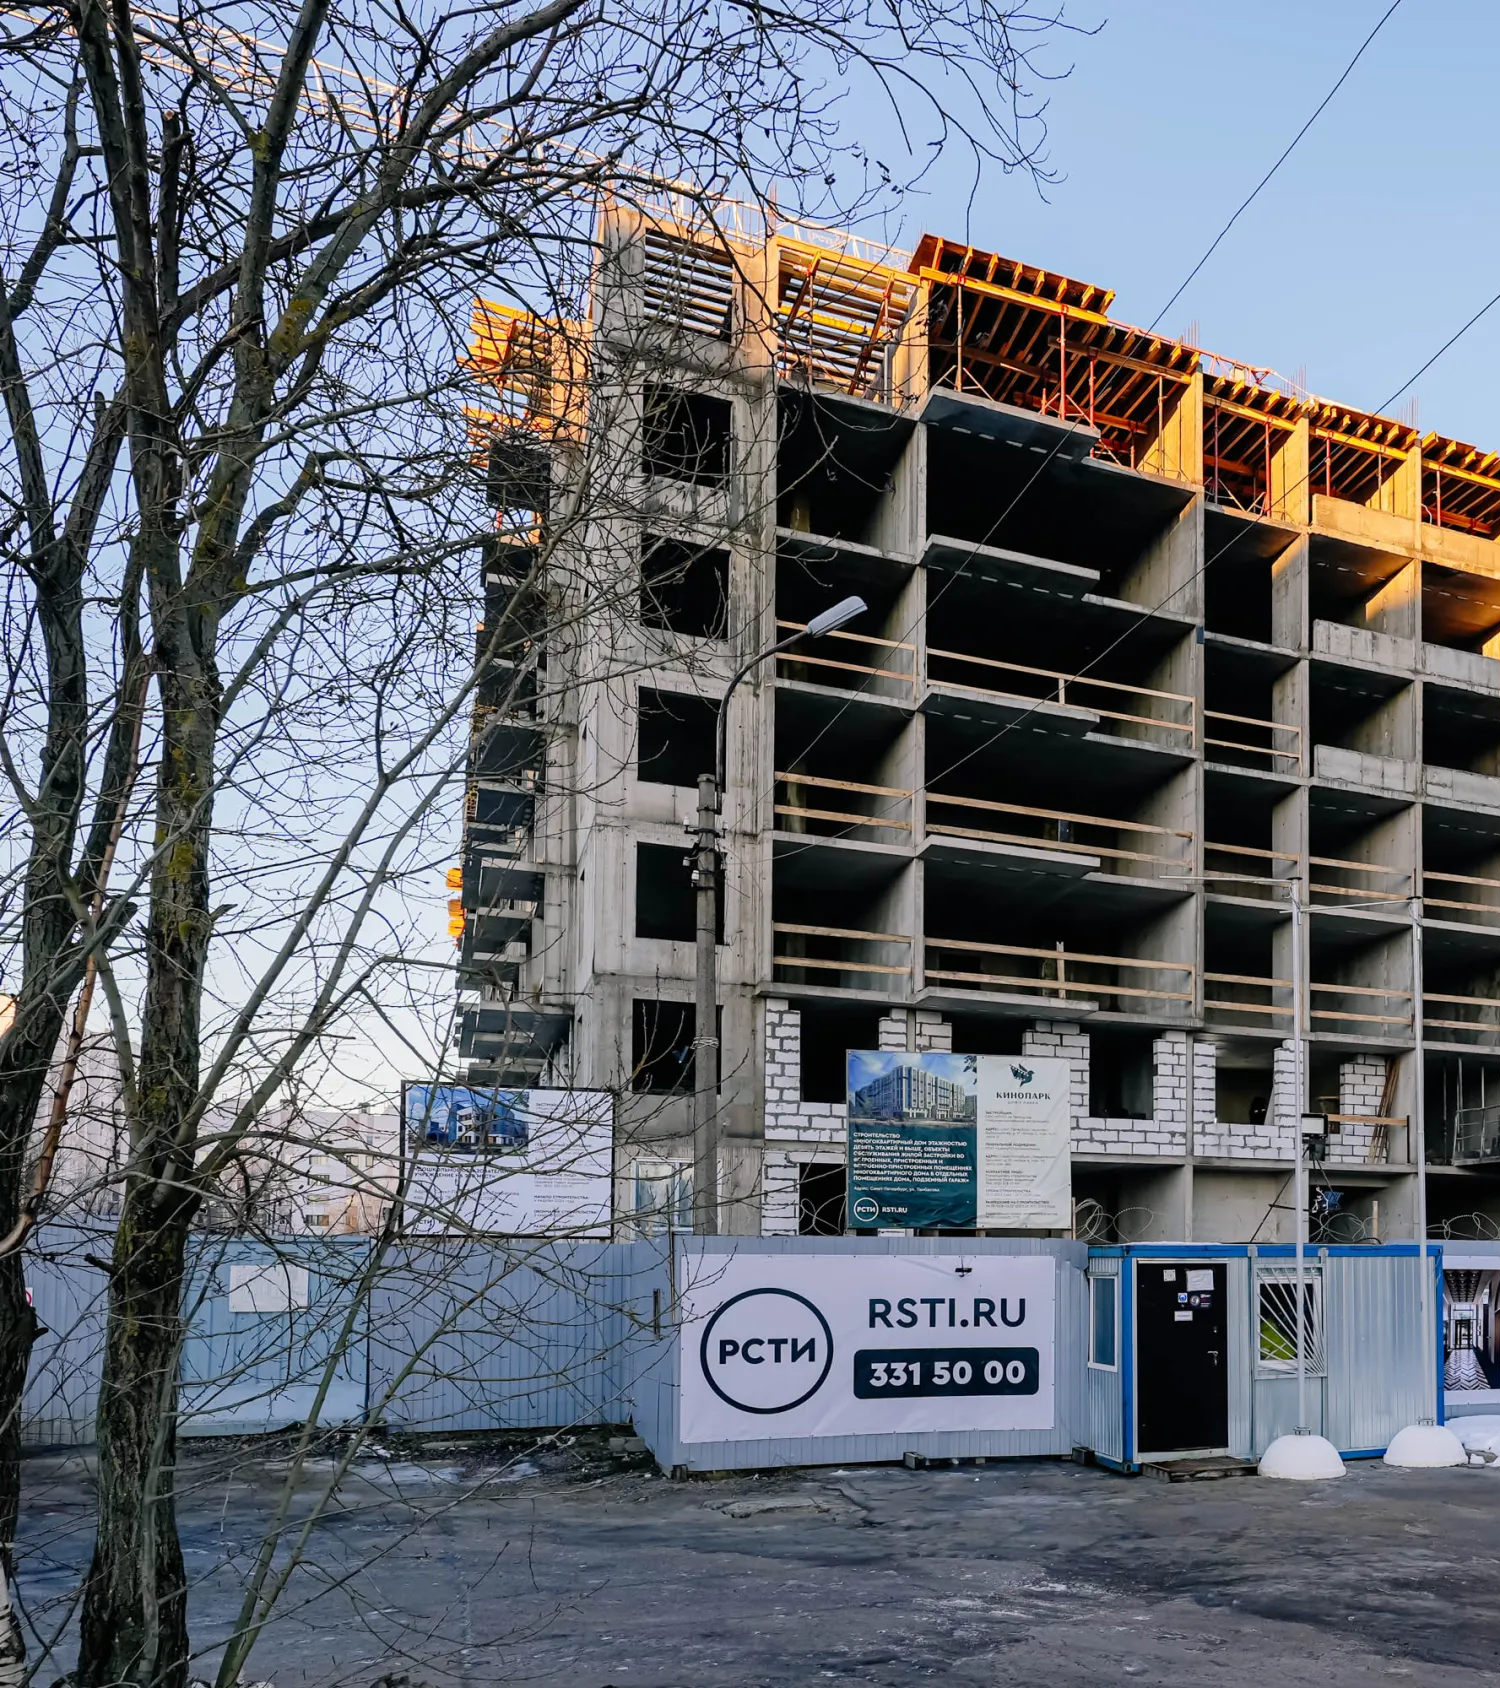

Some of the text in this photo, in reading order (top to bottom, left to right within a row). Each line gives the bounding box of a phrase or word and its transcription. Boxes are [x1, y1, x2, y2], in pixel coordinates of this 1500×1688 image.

[996, 1092, 1051, 1100] КИНОПАРК
[881, 1206, 908, 1214] RSTI.RU
[868, 1297, 1026, 1329] RSTI.RU
[719, 1337, 816, 1365] РСТИ
[869, 1360, 1026, 1387] 331 50 00
